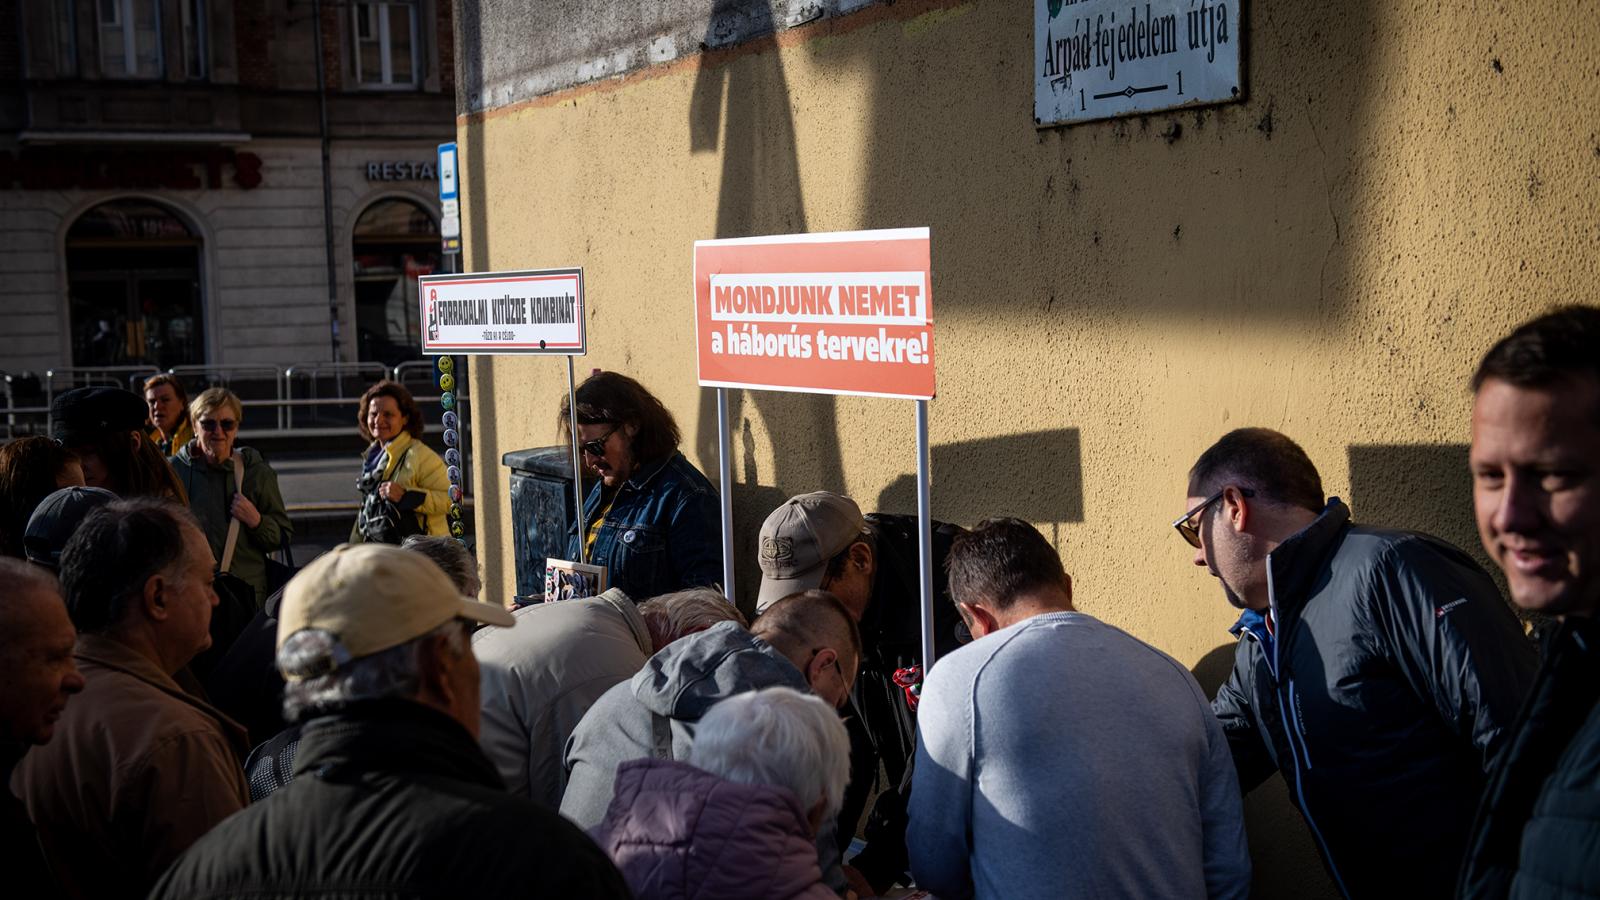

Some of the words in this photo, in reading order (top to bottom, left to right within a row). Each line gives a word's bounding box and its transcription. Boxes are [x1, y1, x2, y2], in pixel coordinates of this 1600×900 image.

[1093, 4, 1177, 80] fejedelem
[1187, 0, 1229, 63] útja
[1176, 70, 1184, 95] 1
[1079, 88, 1087, 111] 1
[367, 161, 440, 180] RESTA
[438, 298, 489, 326] FORRADALMI
[530, 291, 575, 325] KOMBINÁT
[714, 285, 834, 315] MONDJUNK
[838, 285, 920, 317] NEMET
[711, 331, 723, 354] a
[727, 323, 812, 359] háborús
[816, 328, 930, 365] tervekre!
